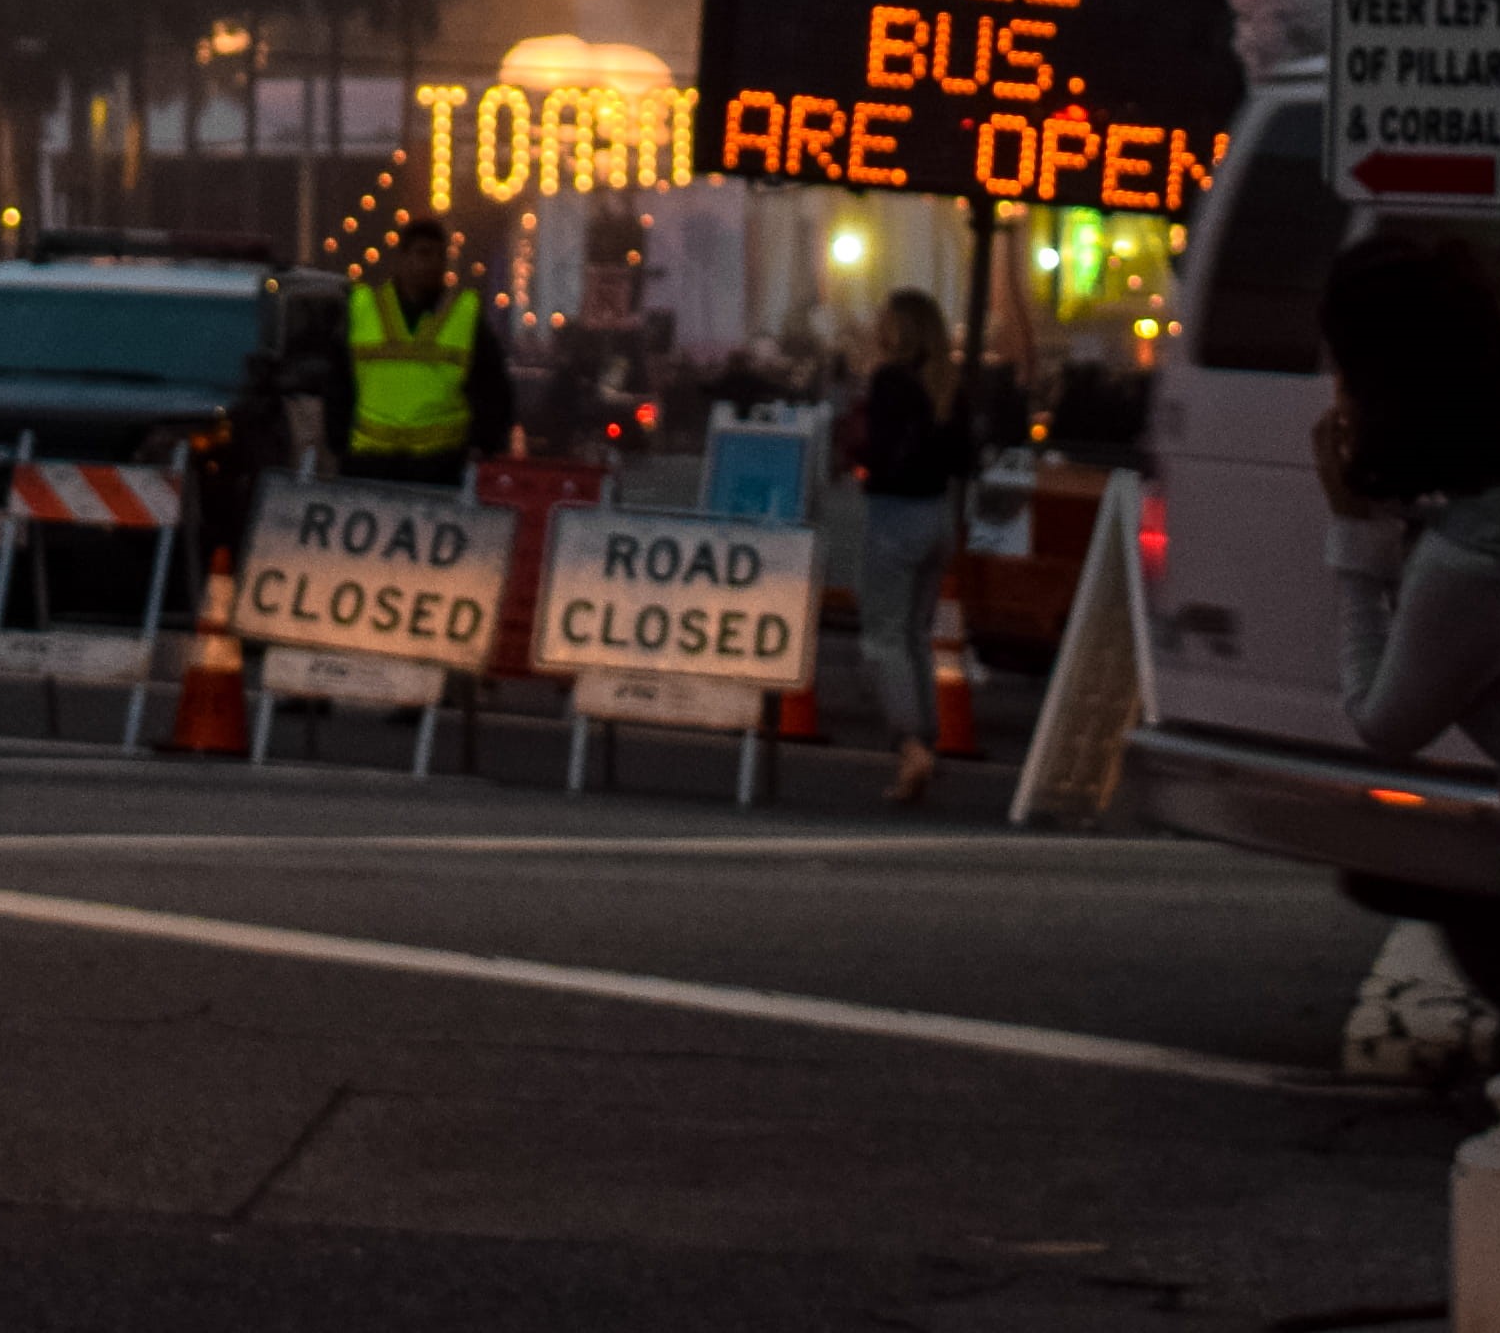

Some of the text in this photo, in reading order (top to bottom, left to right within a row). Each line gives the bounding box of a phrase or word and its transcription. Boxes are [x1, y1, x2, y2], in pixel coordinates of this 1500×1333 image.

[866, 3, 1088, 101] BUS.
[1348, 46, 1387, 83] OF
[721, 87, 1231, 213] ARE OPEN
[1347, 106, 1370, 141] &
[298, 502, 469, 568] ROAD
[604, 532, 763, 589] ROAD
[252, 569, 484, 644] CLOSED
[561, 598, 791, 661] CLOSED
